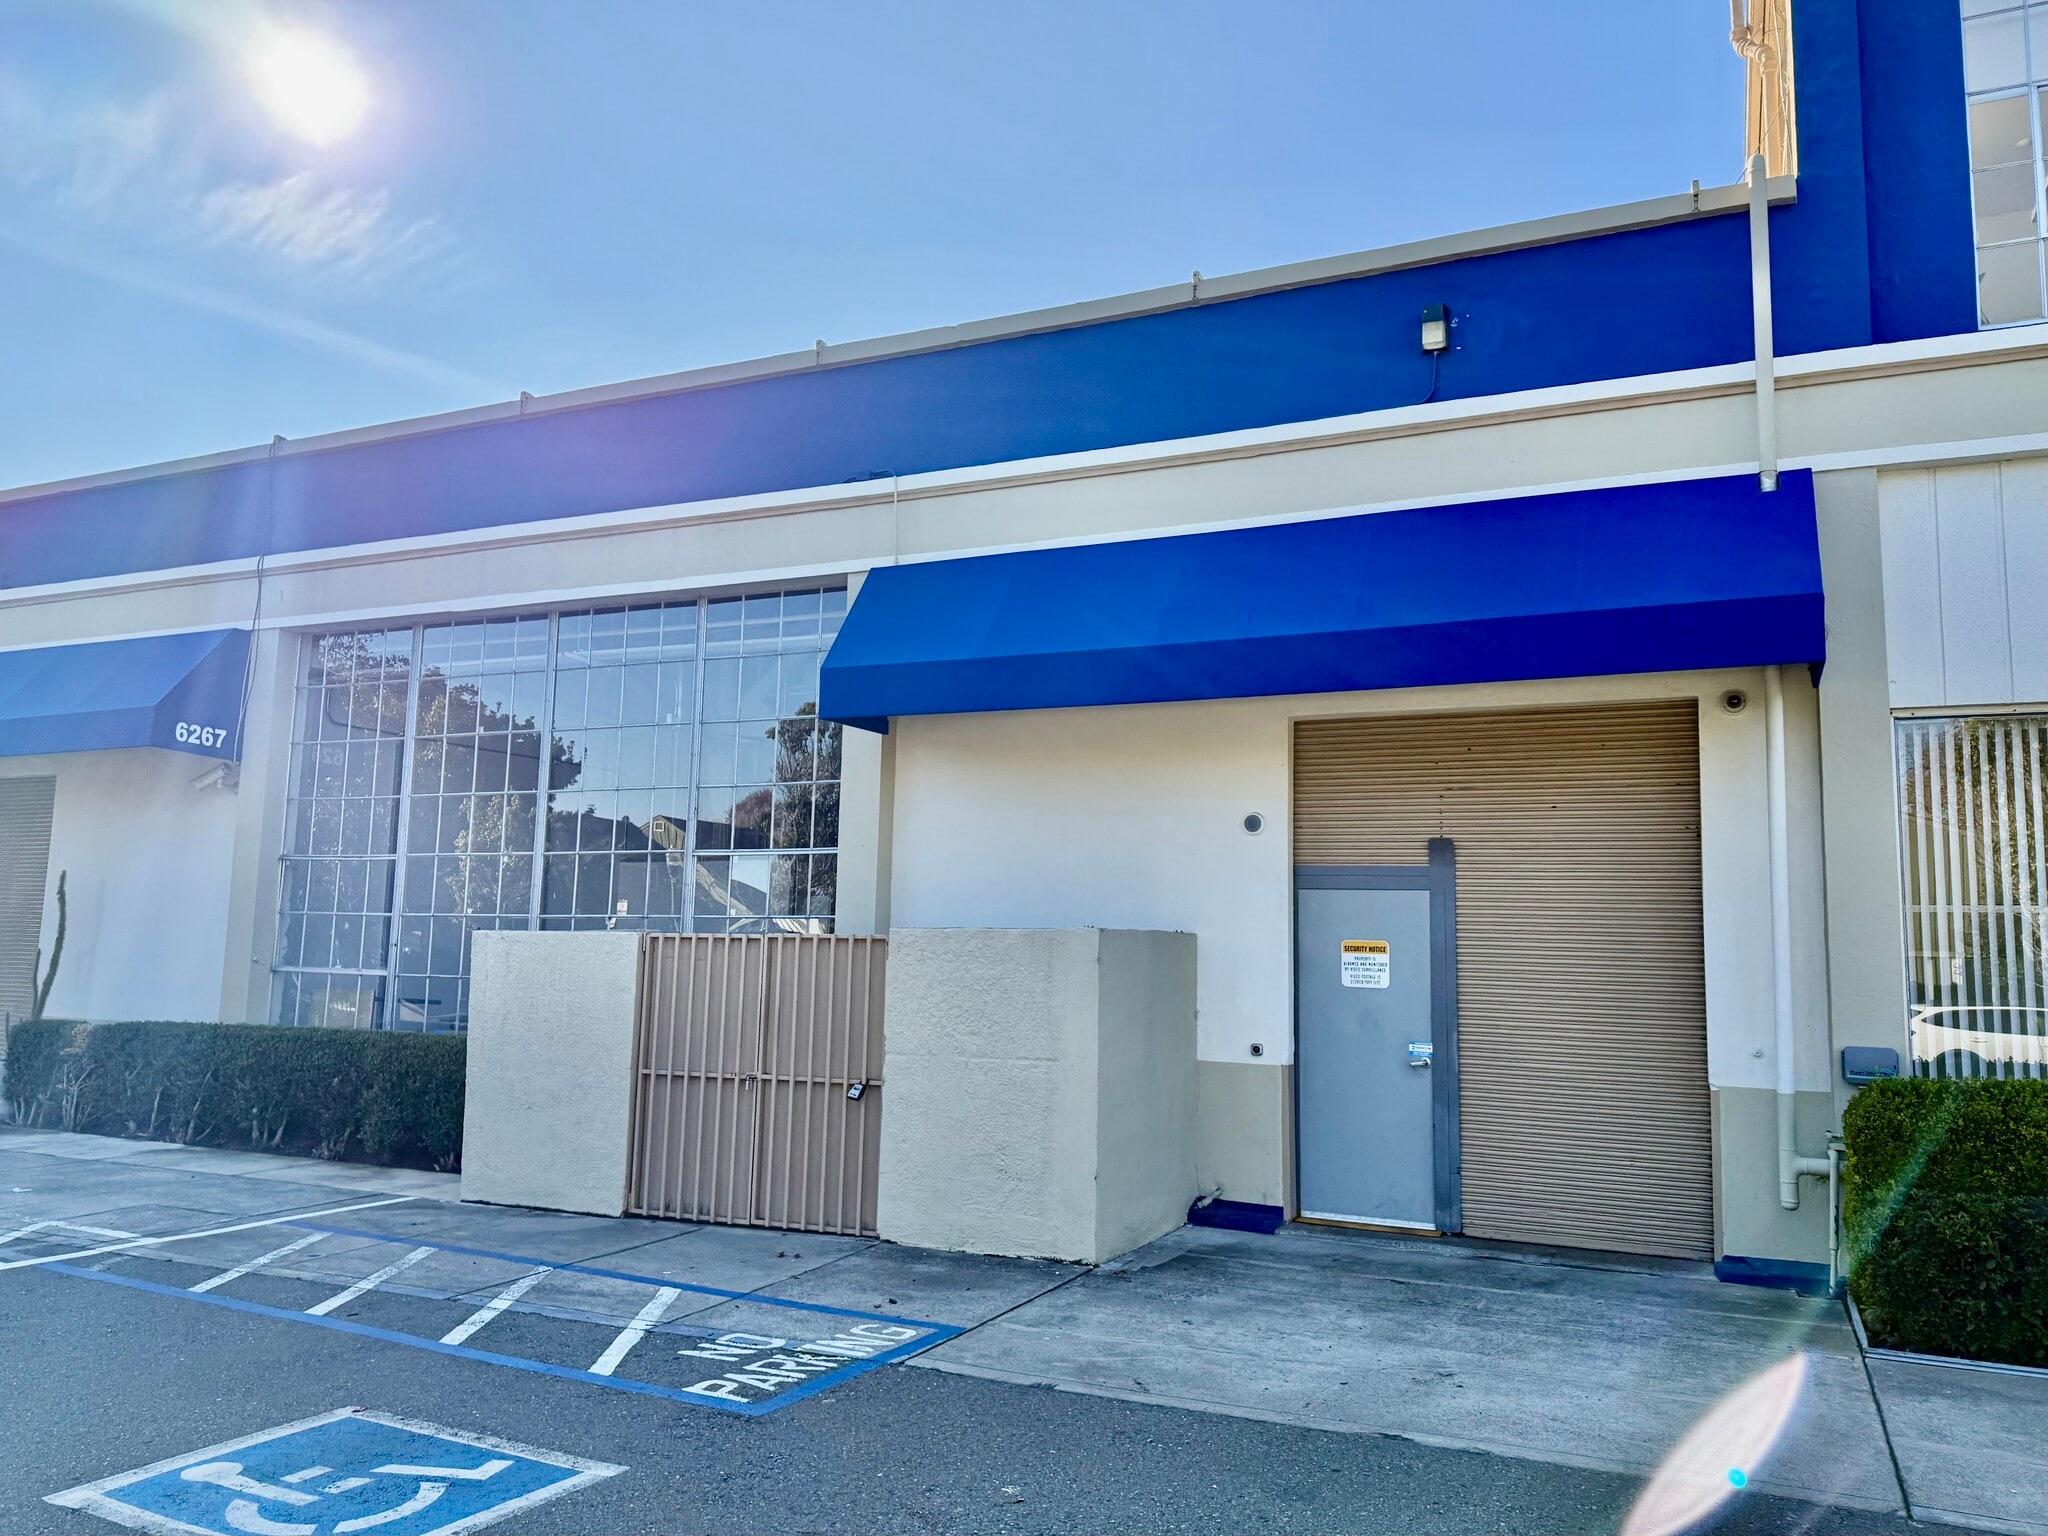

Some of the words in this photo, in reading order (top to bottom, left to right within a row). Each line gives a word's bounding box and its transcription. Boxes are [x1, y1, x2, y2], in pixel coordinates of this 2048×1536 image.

[175, 721, 227, 748] 6267
[677, 1332, 787, 1362] NO
[681, 1324, 918, 1403] PARKING
